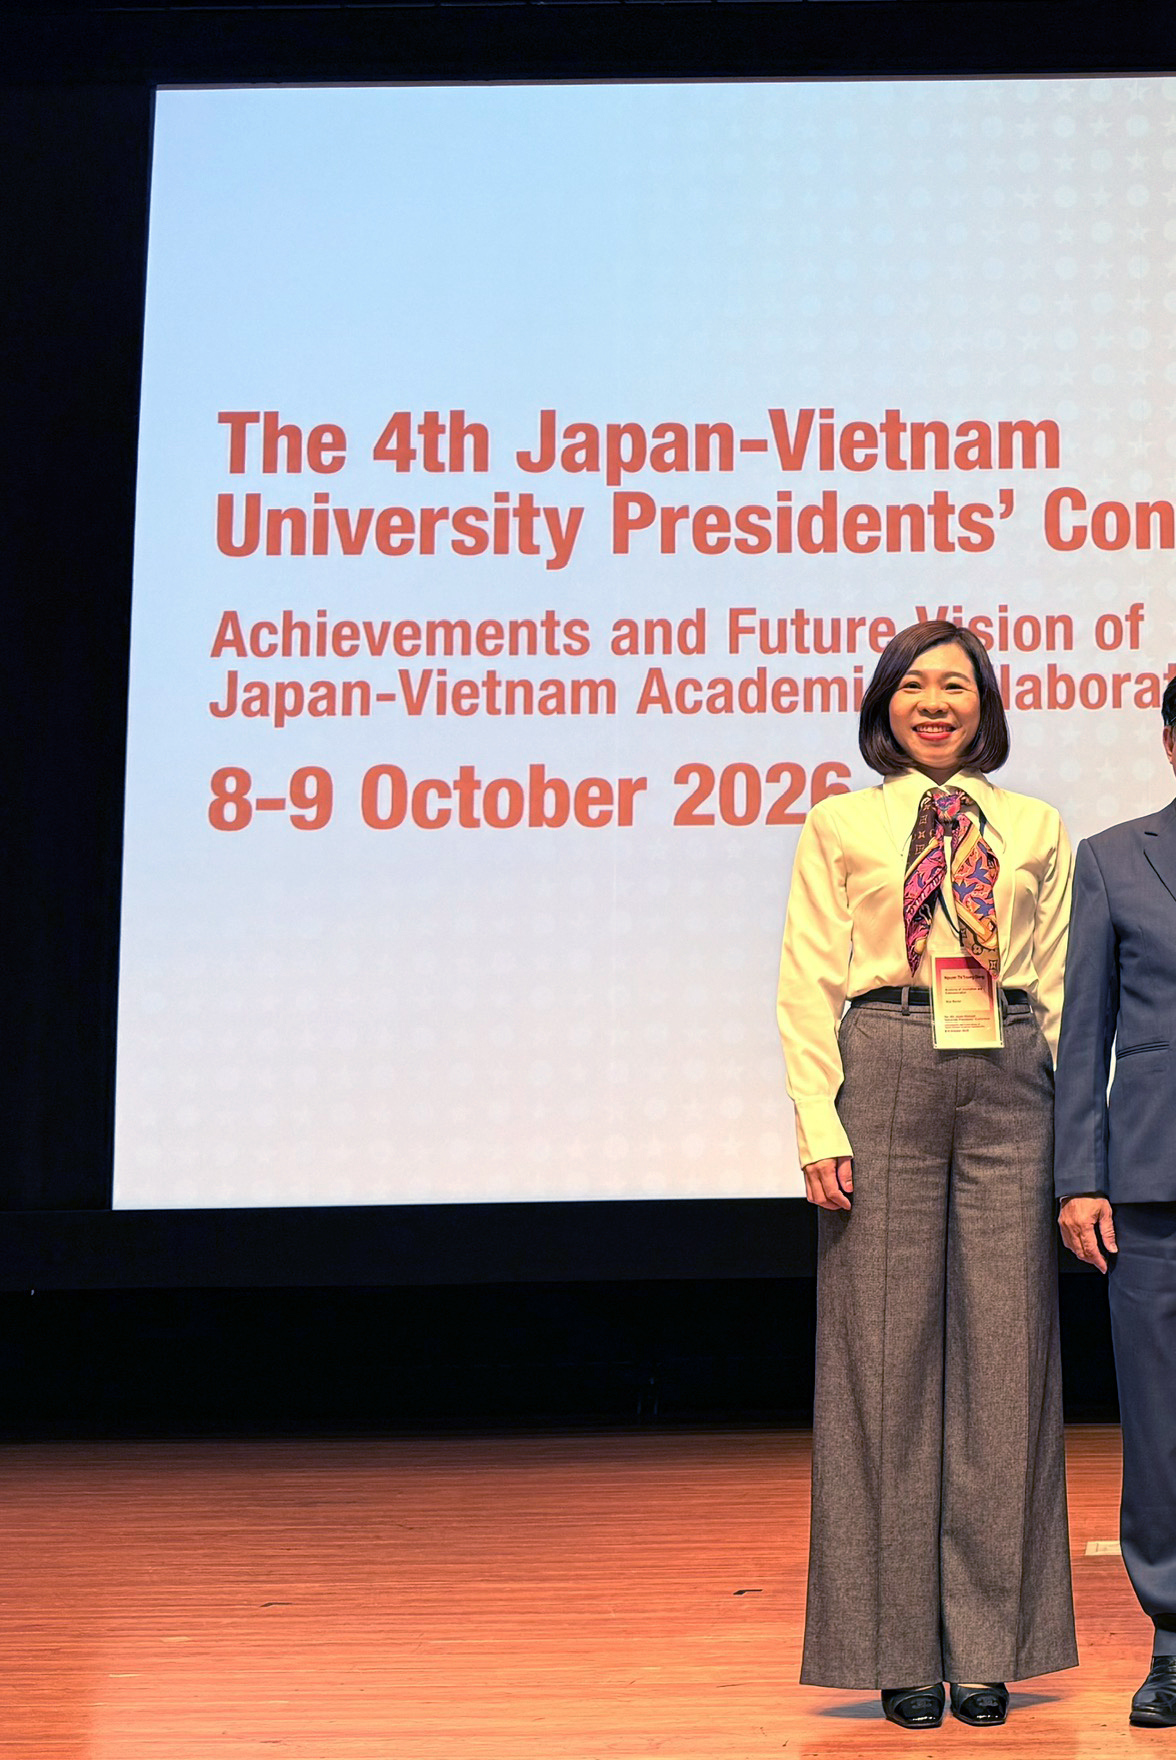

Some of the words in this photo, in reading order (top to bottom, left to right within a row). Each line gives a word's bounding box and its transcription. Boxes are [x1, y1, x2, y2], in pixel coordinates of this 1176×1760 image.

[219, 412, 346, 475] The
[374, 411, 489, 473] 4th
[517, 409, 1060, 487] Japan-Vietnam
[215, 491, 583, 570] University
[211, 609, 590, 658] Achievements
[611, 608, 706, 656] and
[728, 607, 896, 655] Future
[1095, 603, 1145, 652] of
[209, 668, 616, 728] Japan-Vietnam
[637, 668, 863, 715] Academi
[361, 762, 648, 831] October
[673, 761, 852, 826] 2026
